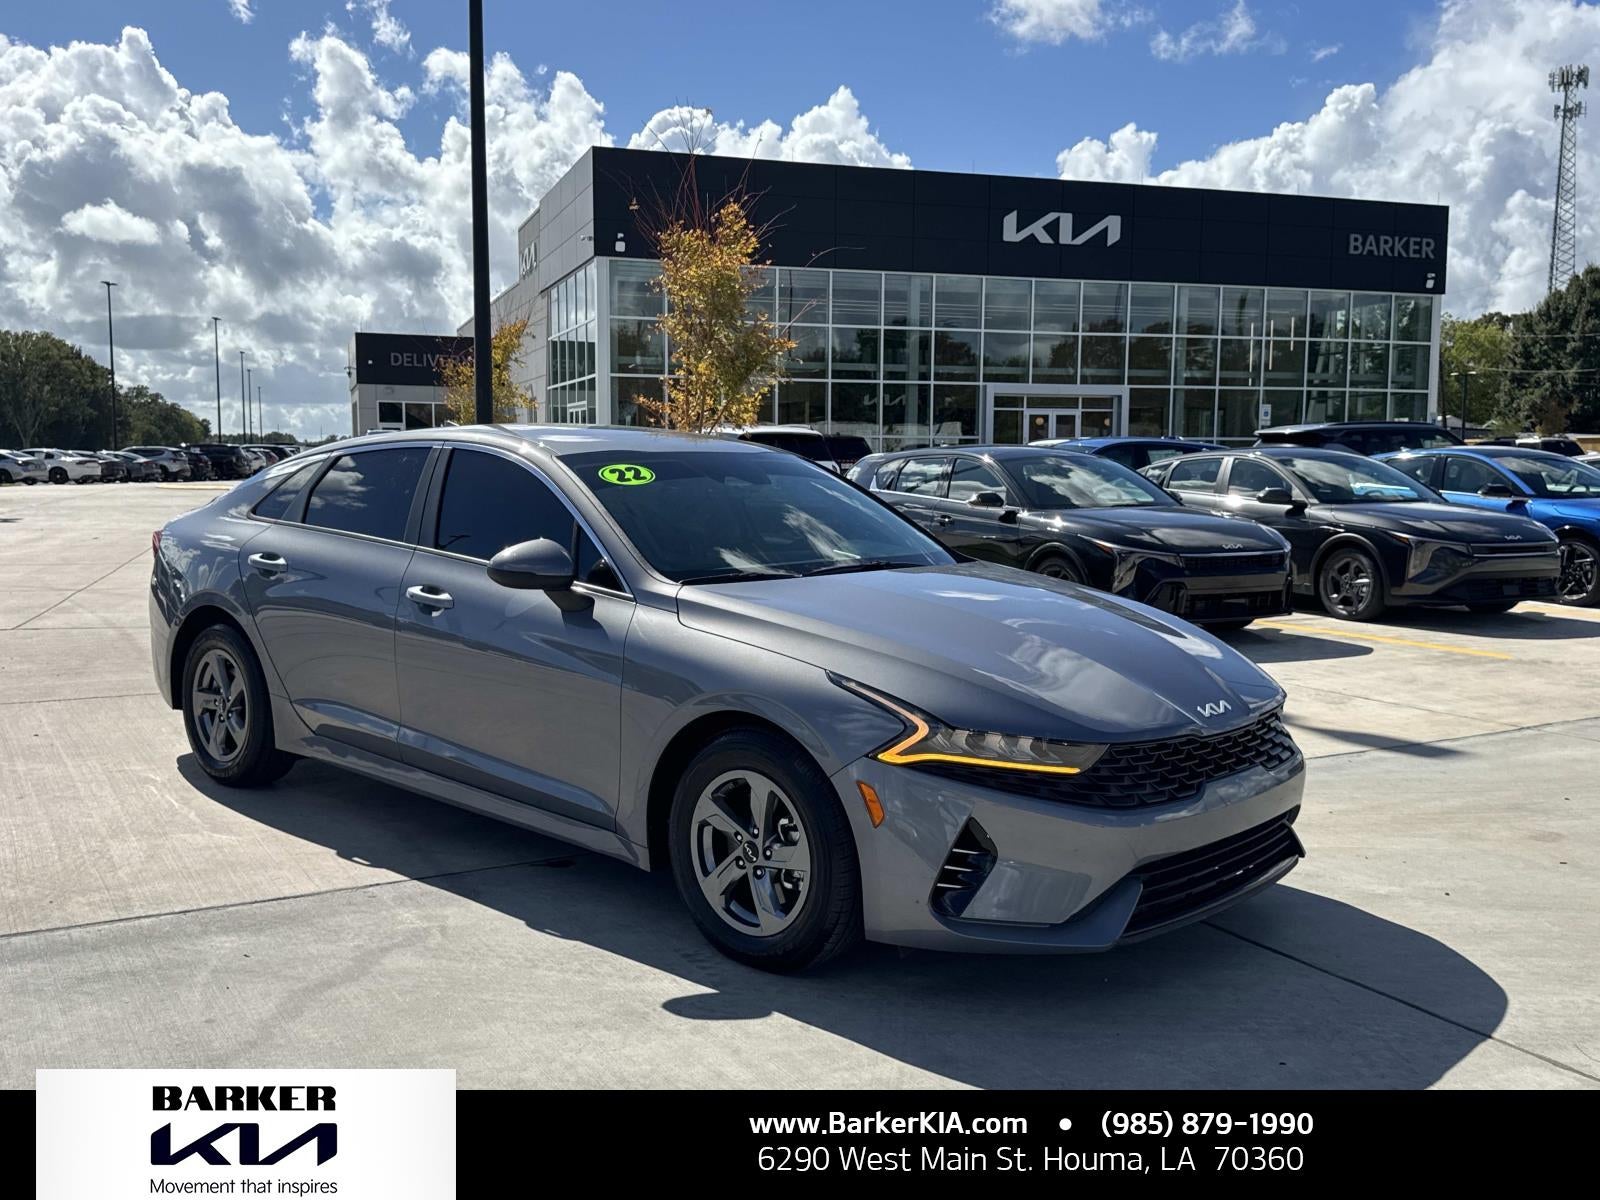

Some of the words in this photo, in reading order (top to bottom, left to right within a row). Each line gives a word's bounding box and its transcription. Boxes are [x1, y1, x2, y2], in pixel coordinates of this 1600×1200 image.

[1003, 209, 1121, 247] KIA
[1348, 233, 1435, 259] BARKER
[609, 466, 647, 482] 22
[1197, 700, 1231, 717] KIA
